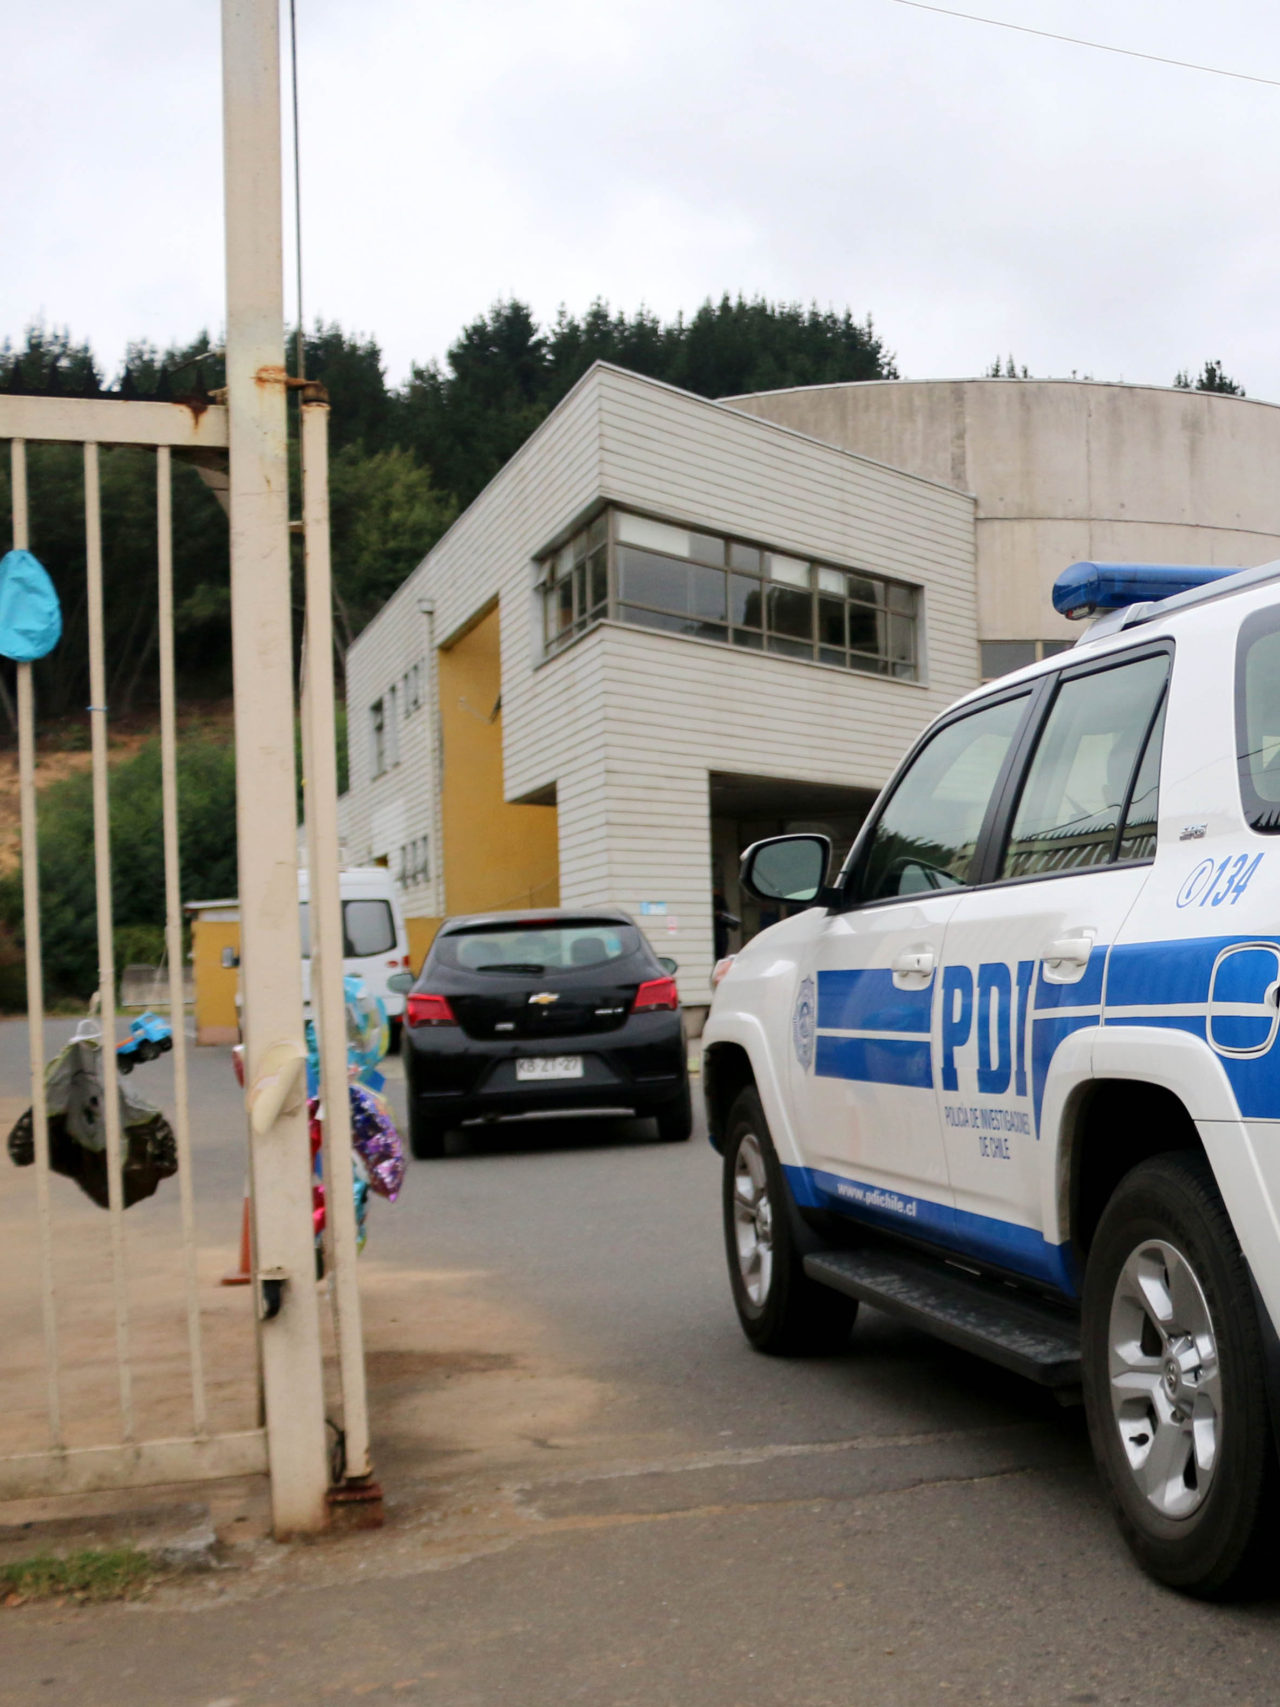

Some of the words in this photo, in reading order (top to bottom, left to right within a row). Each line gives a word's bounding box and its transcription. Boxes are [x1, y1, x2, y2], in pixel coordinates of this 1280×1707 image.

[1199, 851, 1264, 907] 134
[941, 960, 1035, 1096] PDI
[969, 1107, 980, 1129] DE
[979, 1136, 990, 1158] DE
[990, 1137, 1011, 1160] CHILE
[836, 1182, 917, 1217] www.pdichile.cl
